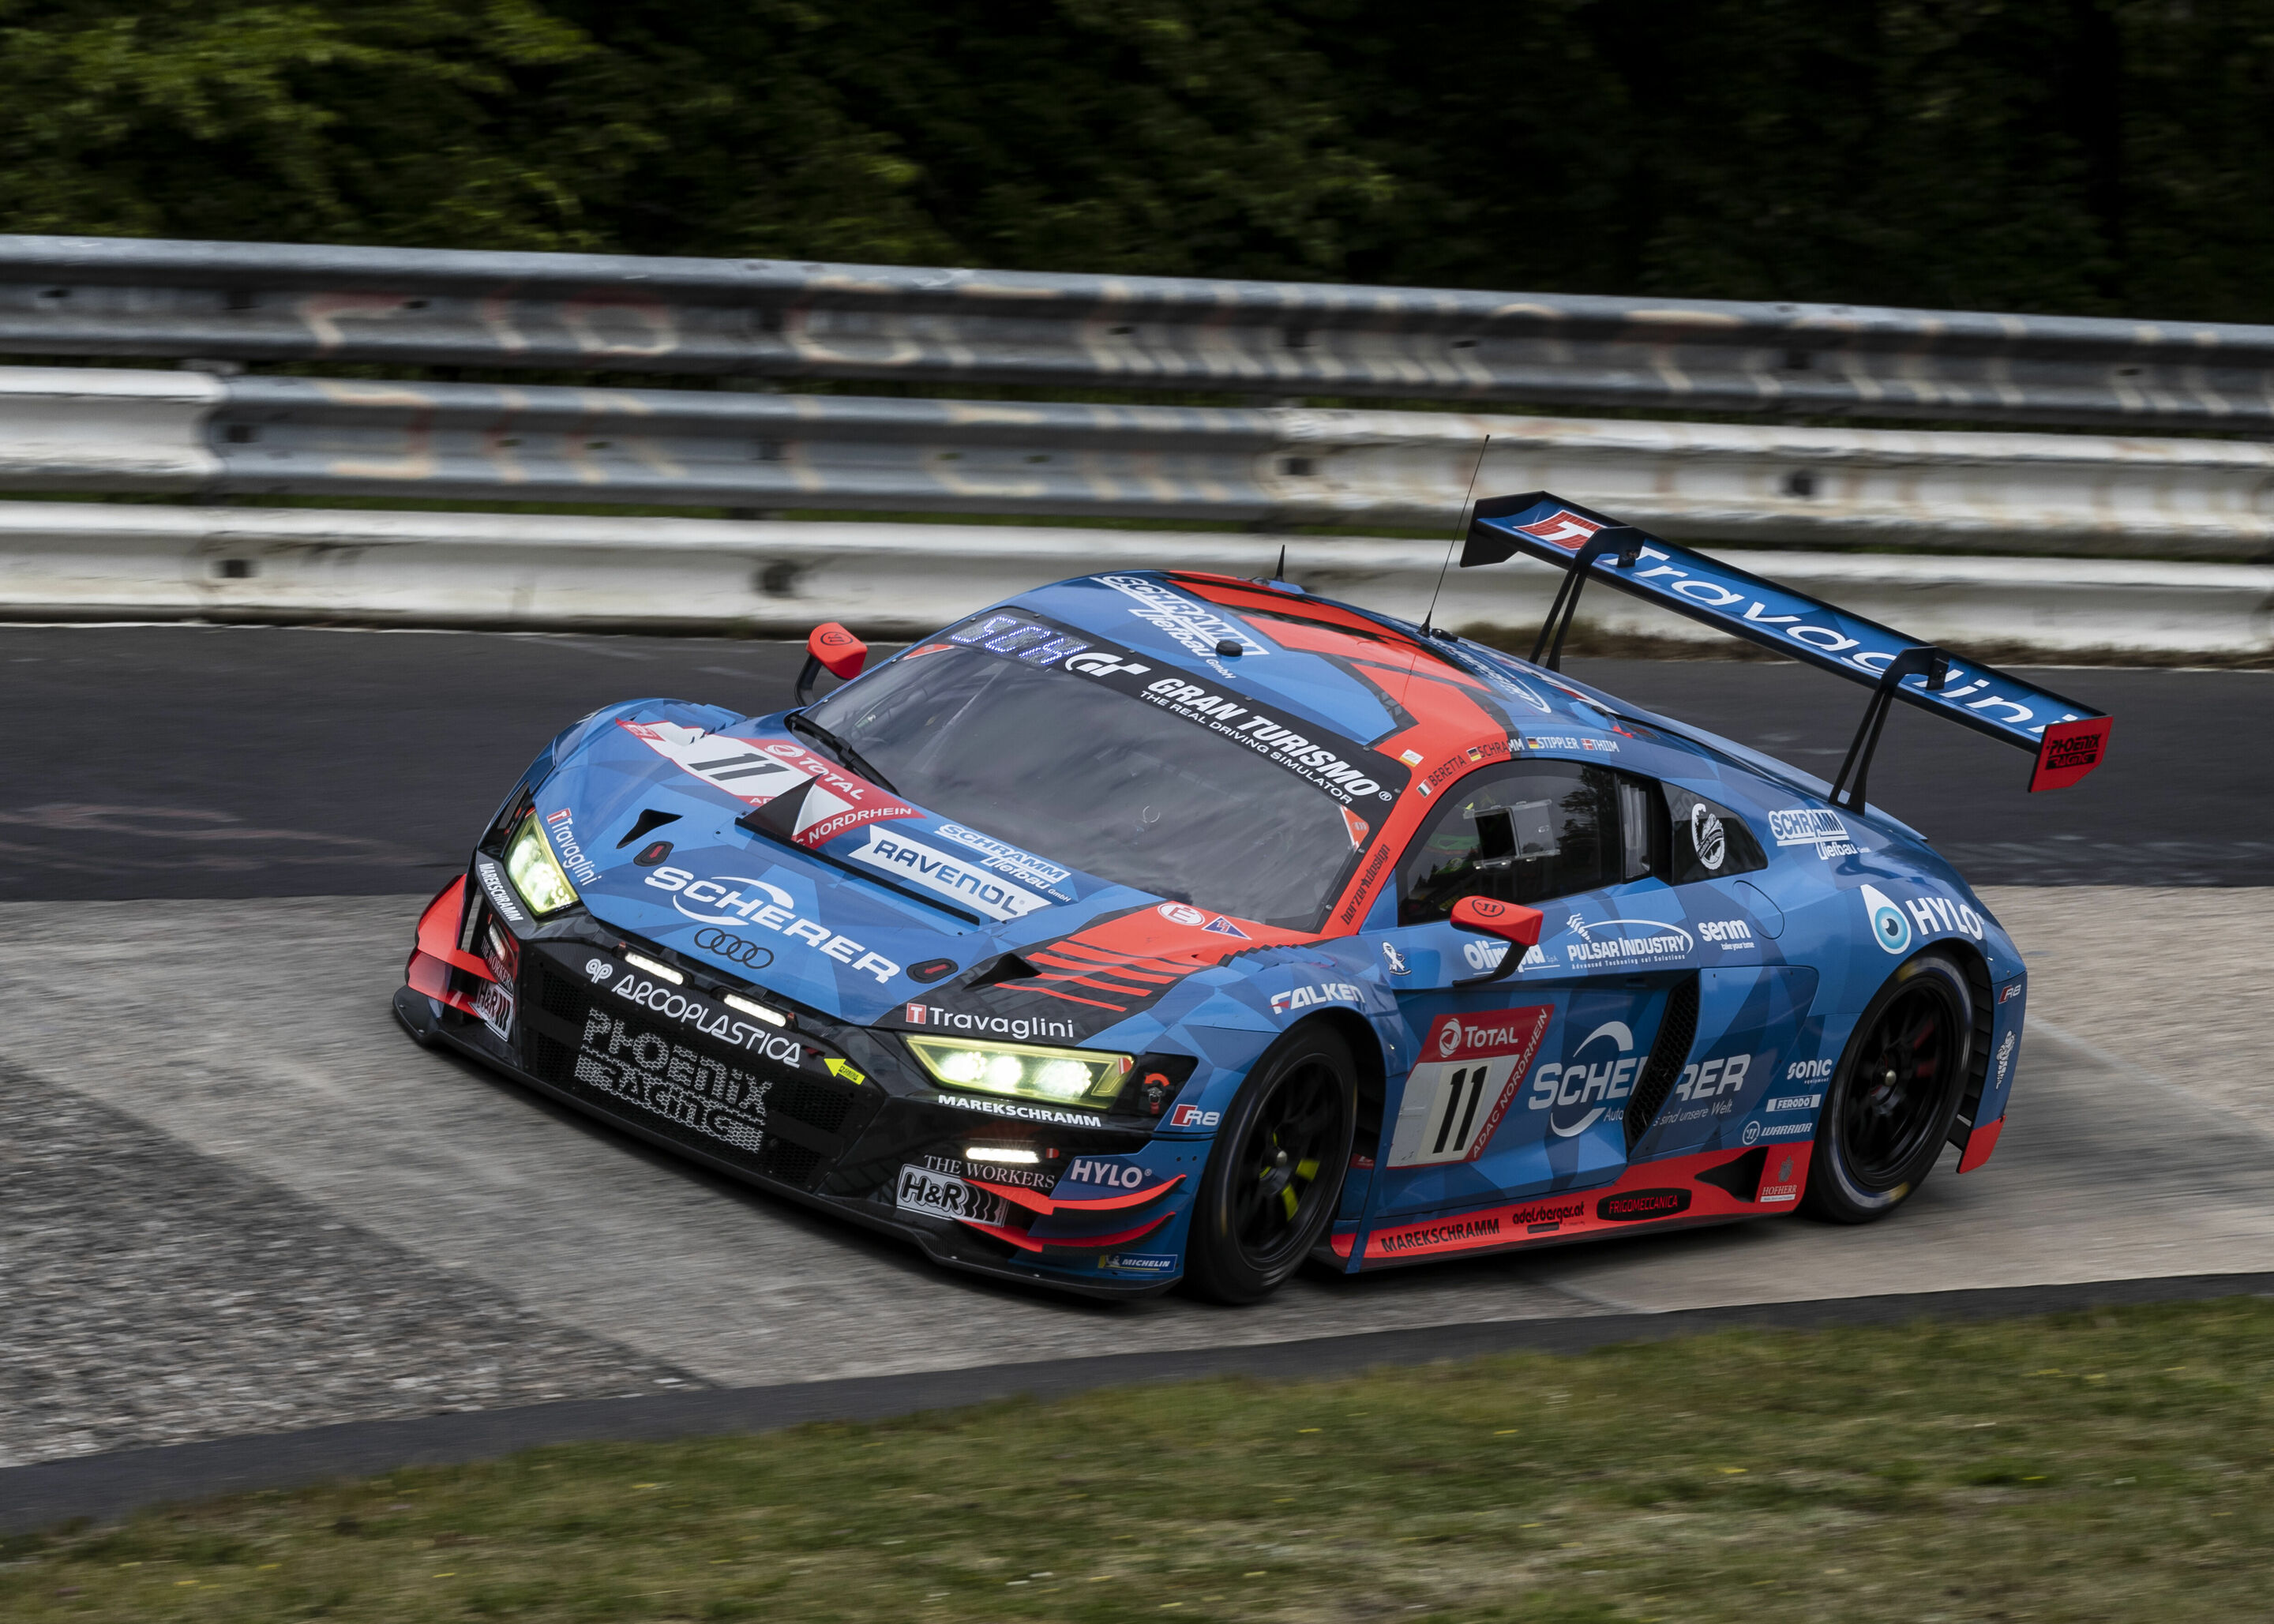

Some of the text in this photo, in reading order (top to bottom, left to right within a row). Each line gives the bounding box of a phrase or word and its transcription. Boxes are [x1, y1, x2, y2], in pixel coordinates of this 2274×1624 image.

[1206, 658, 1236, 679] GmbH
[1147, 678, 1248, 722] GRAN
[1140, 690, 1353, 804] THE REAL DRIVING SIMULATOR
[1477, 737, 1524, 758] SCHRAMM
[1537, 737, 1580, 750] STIPPLER
[1590, 739, 1620, 752] THIIM
[687, 752, 791, 782] 11
[798, 756, 866, 801] TOTAL
[1428, 755, 1466, 787] BERETTA
[808, 808, 912, 846] NORDRHEIN
[1769, 809, 1848, 840] SCHRAMM
[551, 817, 602, 887] Travaglini
[939, 824, 1071, 883] SCHRAMM
[478, 863, 523, 921] MAREKSCHRAMM
[872, 839, 1020, 917] RAVENOL
[1048, 888, 1071, 902] GmbH
[644, 866, 901, 985] SCHERER
[1567, 935, 1685, 962] PULSAR INDUSTRY
[1269, 983, 1366, 1015] FALKEN
[611, 974, 801, 1069] ARCOPLASTICA
[929, 1007, 1075, 1039] Travaglini
[1465, 1026, 1519, 1048] TOTAL
[1473, 1008, 1548, 1158] ADAC NORDRHEIN
[938, 1094, 1102, 1127] MAREKSCHRAMM
[1432, 1066, 1488, 1154] 11
[1661, 1108, 1680, 1124] sind
[1679, 1107, 1709, 1120] unsere
[1777, 1097, 1811, 1109] FERODO
[1761, 1123, 1813, 1137] WARRIOR
[924, 1155, 1055, 1189] THE WORKERS
[900, 1172, 965, 1215] H&R
[1608, 1195, 1679, 1214] FRIGOMECCANICA
[1762, 1184, 1798, 1195] HOFHERR
[1381, 1218, 1500, 1252] MAREKSCHRAMM
[1121, 1258, 1171, 1268] MICHELIN
